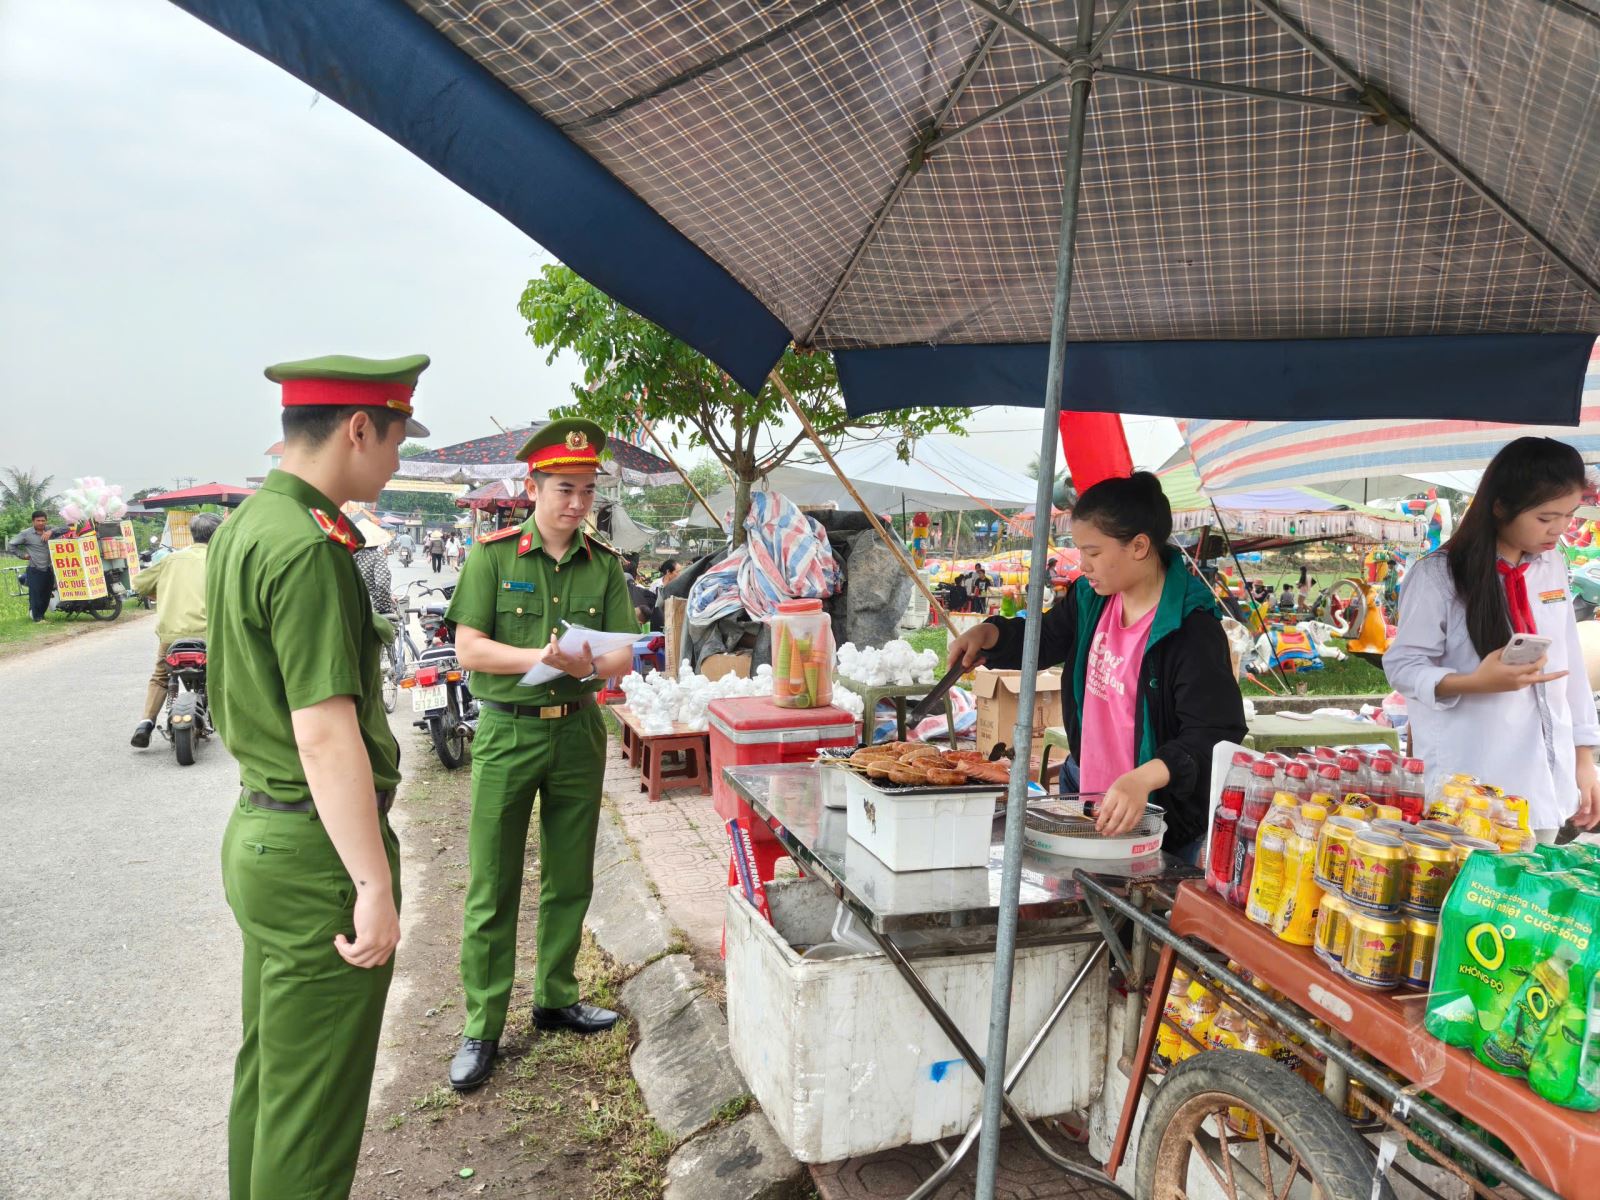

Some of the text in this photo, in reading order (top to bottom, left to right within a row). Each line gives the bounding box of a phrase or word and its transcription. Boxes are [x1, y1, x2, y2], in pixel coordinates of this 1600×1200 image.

[740, 827, 761, 889] ANNAPURNA
[1466, 890, 1495, 908] Giải
[1523, 914, 1559, 934] cuộc
[1557, 926, 1589, 951] sống
[1458, 963, 1489, 985] KHÔNG
